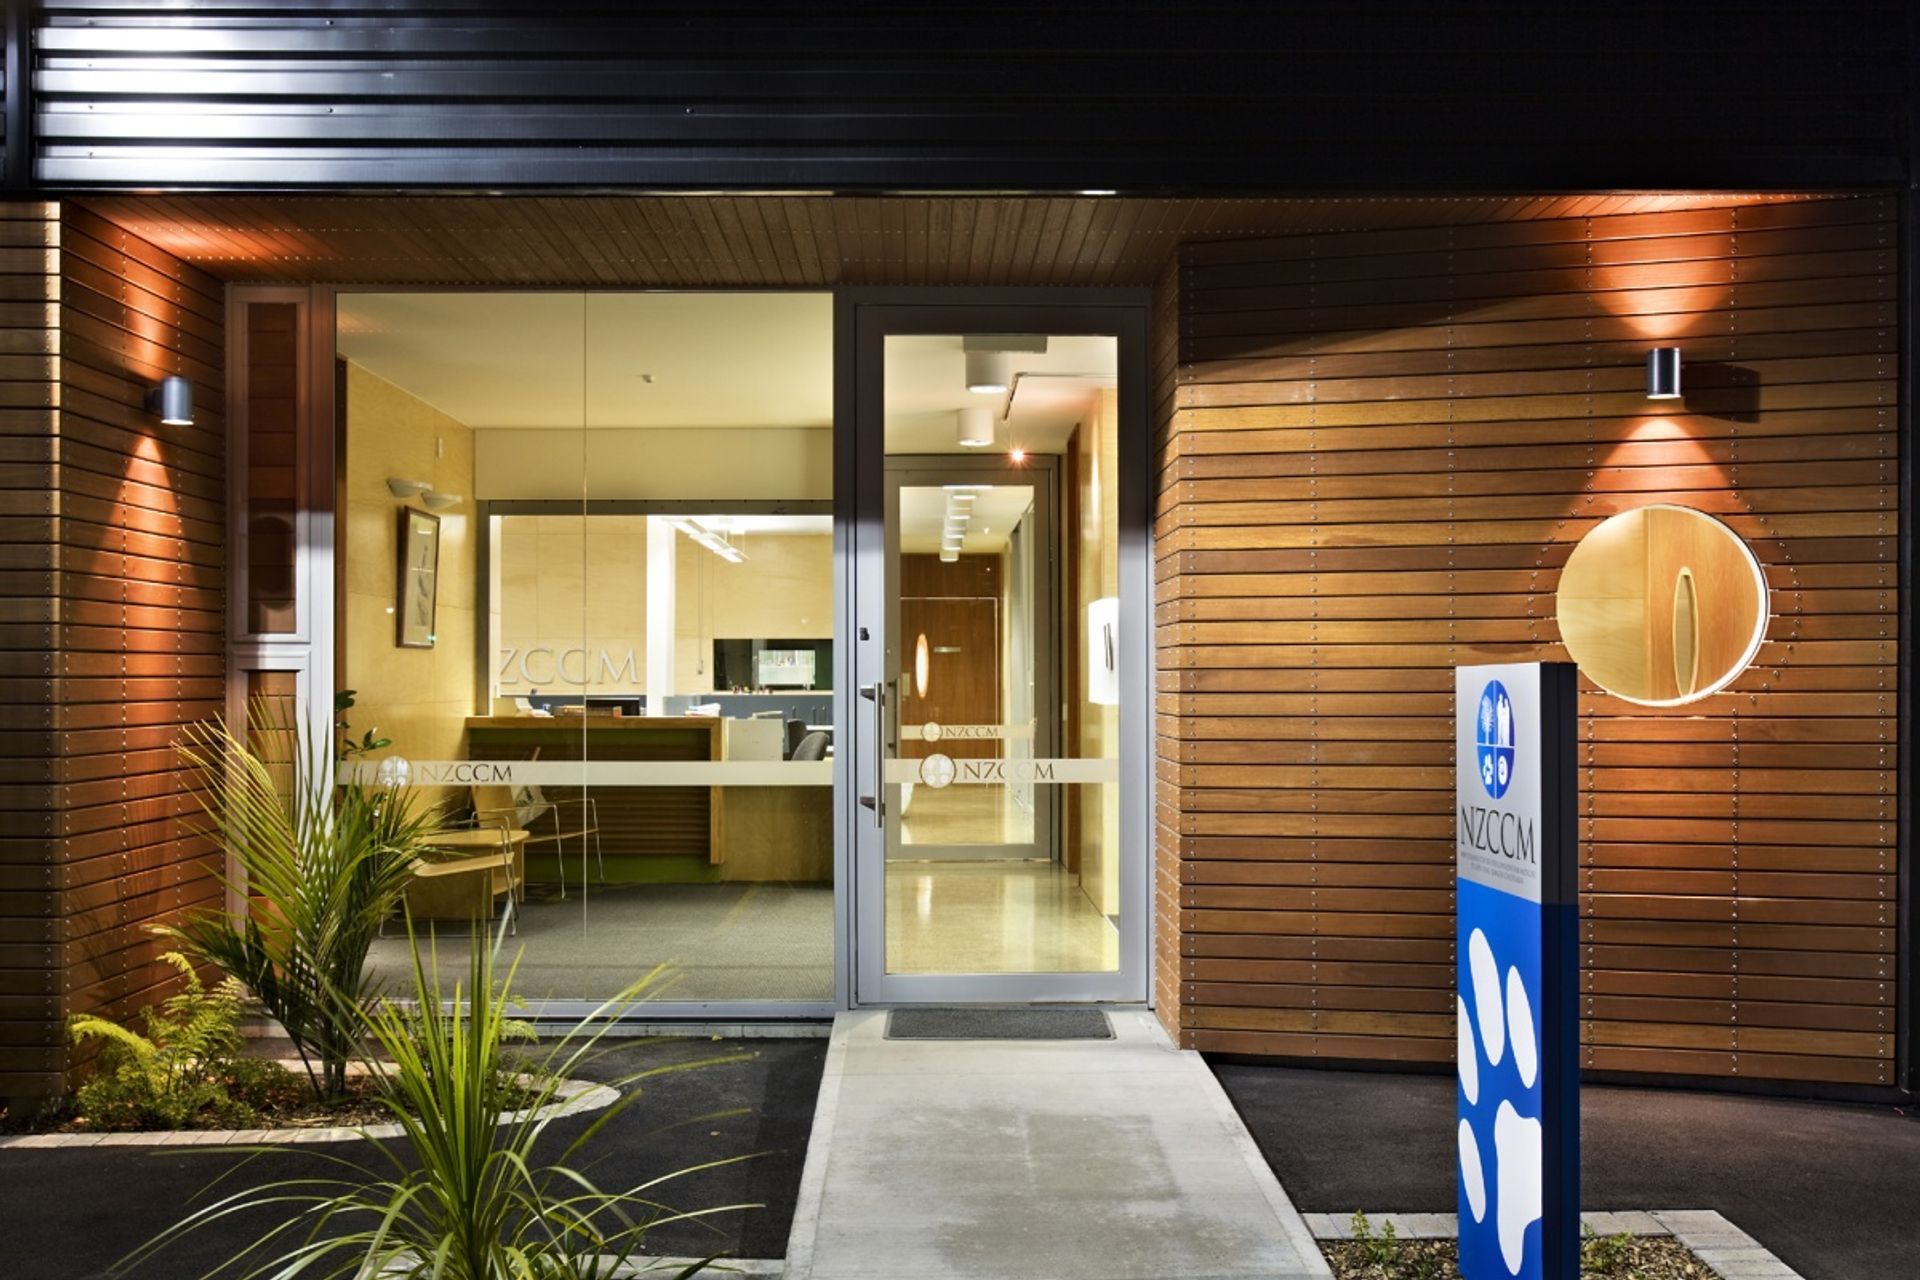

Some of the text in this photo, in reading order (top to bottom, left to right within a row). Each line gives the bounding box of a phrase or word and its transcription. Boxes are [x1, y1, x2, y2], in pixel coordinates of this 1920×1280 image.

[945, 727, 999, 737] NZCCM
[420, 763, 513, 782] NZCCM
[963, 762, 1055, 780] NZCCM
[1460, 805, 1536, 865] NZCCM
